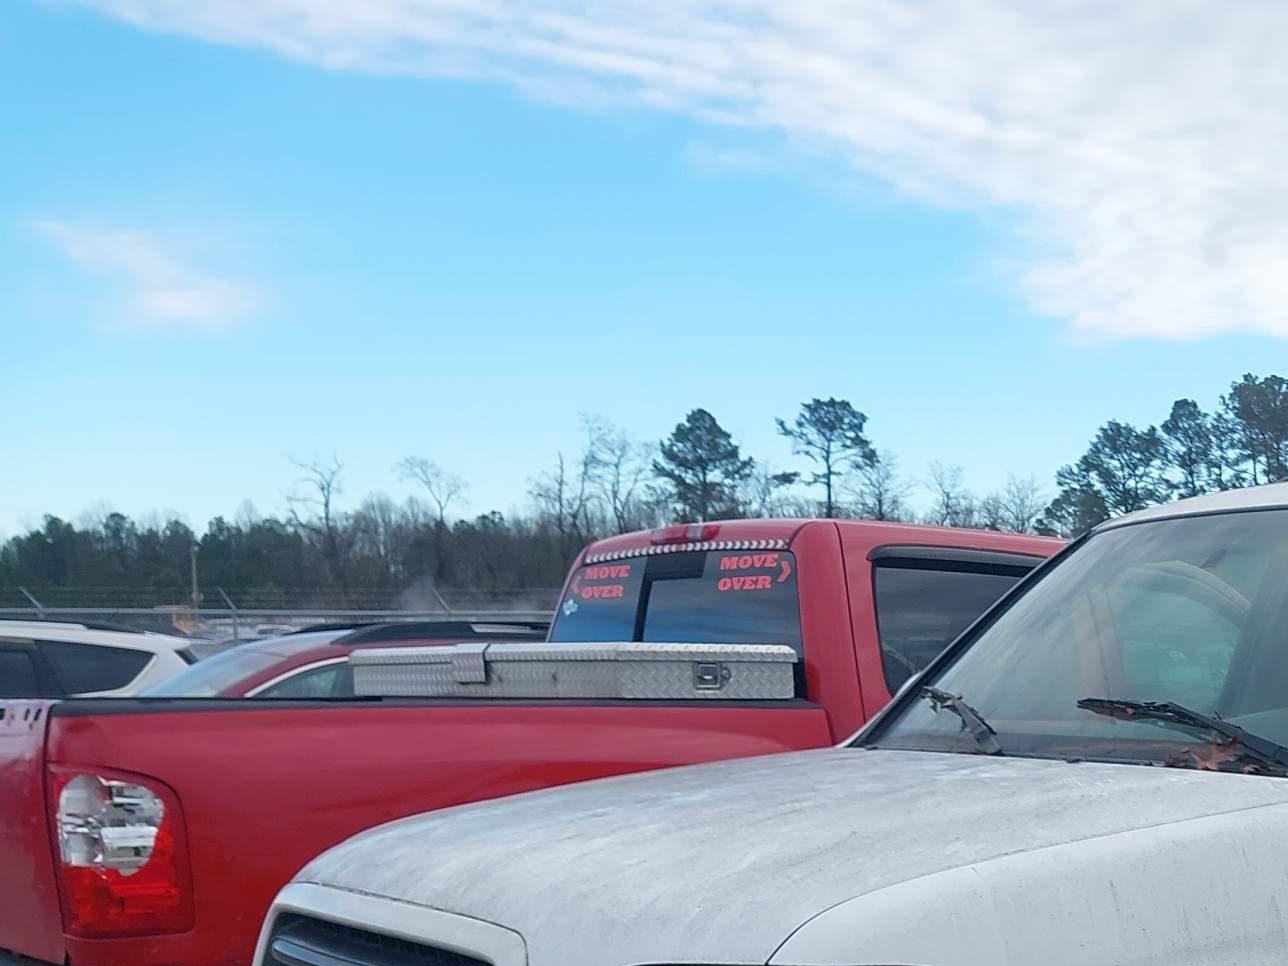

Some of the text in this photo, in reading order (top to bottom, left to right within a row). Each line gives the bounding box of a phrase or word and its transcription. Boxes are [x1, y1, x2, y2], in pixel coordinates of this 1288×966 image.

[719, 554, 779, 570] MOVE
[584, 565, 631, 580] MOVE
[717, 575, 773, 592] OVER
[581, 585, 624, 599] OVER
